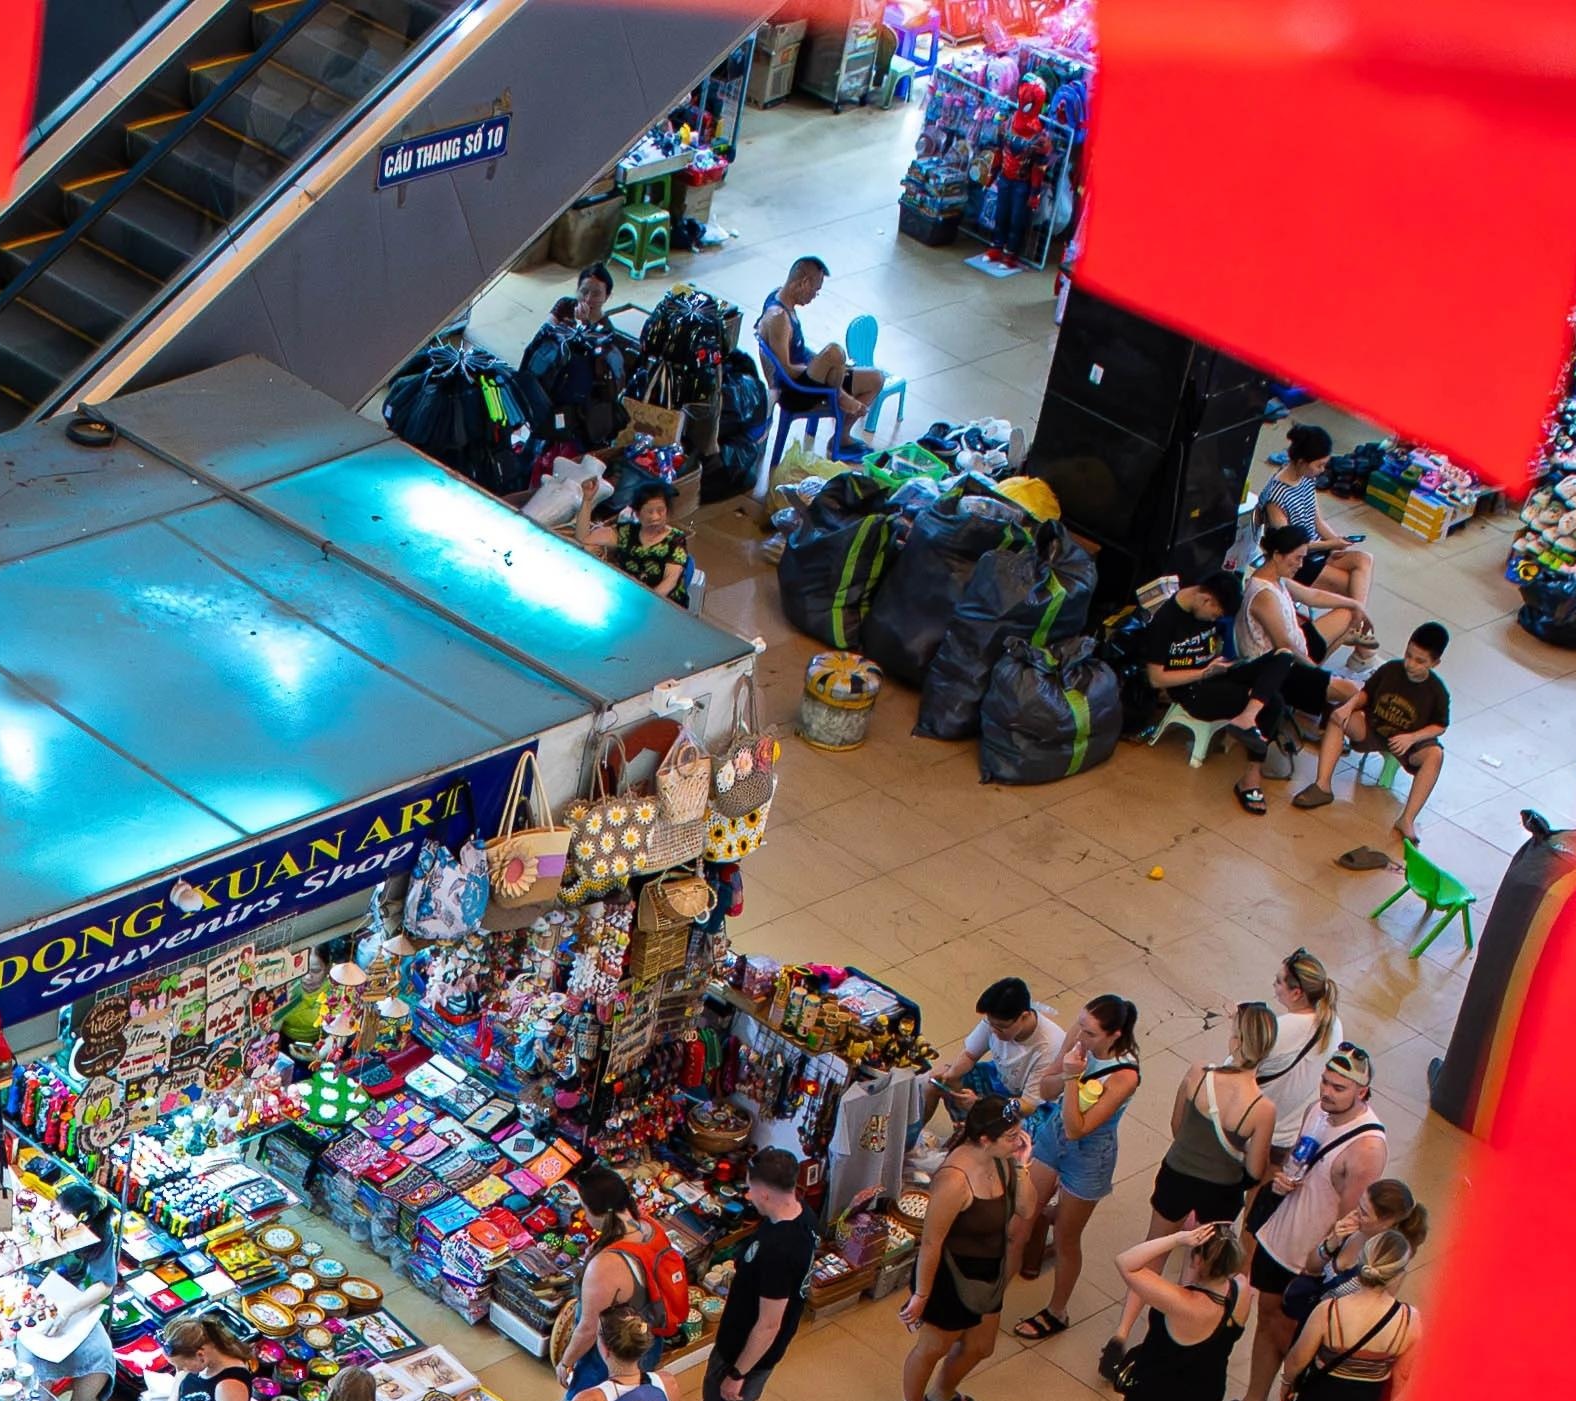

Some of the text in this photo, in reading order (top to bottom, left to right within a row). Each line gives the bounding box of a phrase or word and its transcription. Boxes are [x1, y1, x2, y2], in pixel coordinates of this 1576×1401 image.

[384, 123, 504, 178] CẦU THANG SỐ 10
[181, 831, 345, 917] XUAN
[355, 784, 465, 852] ART
[41, 841, 415, 998] Souvenirs Shop
